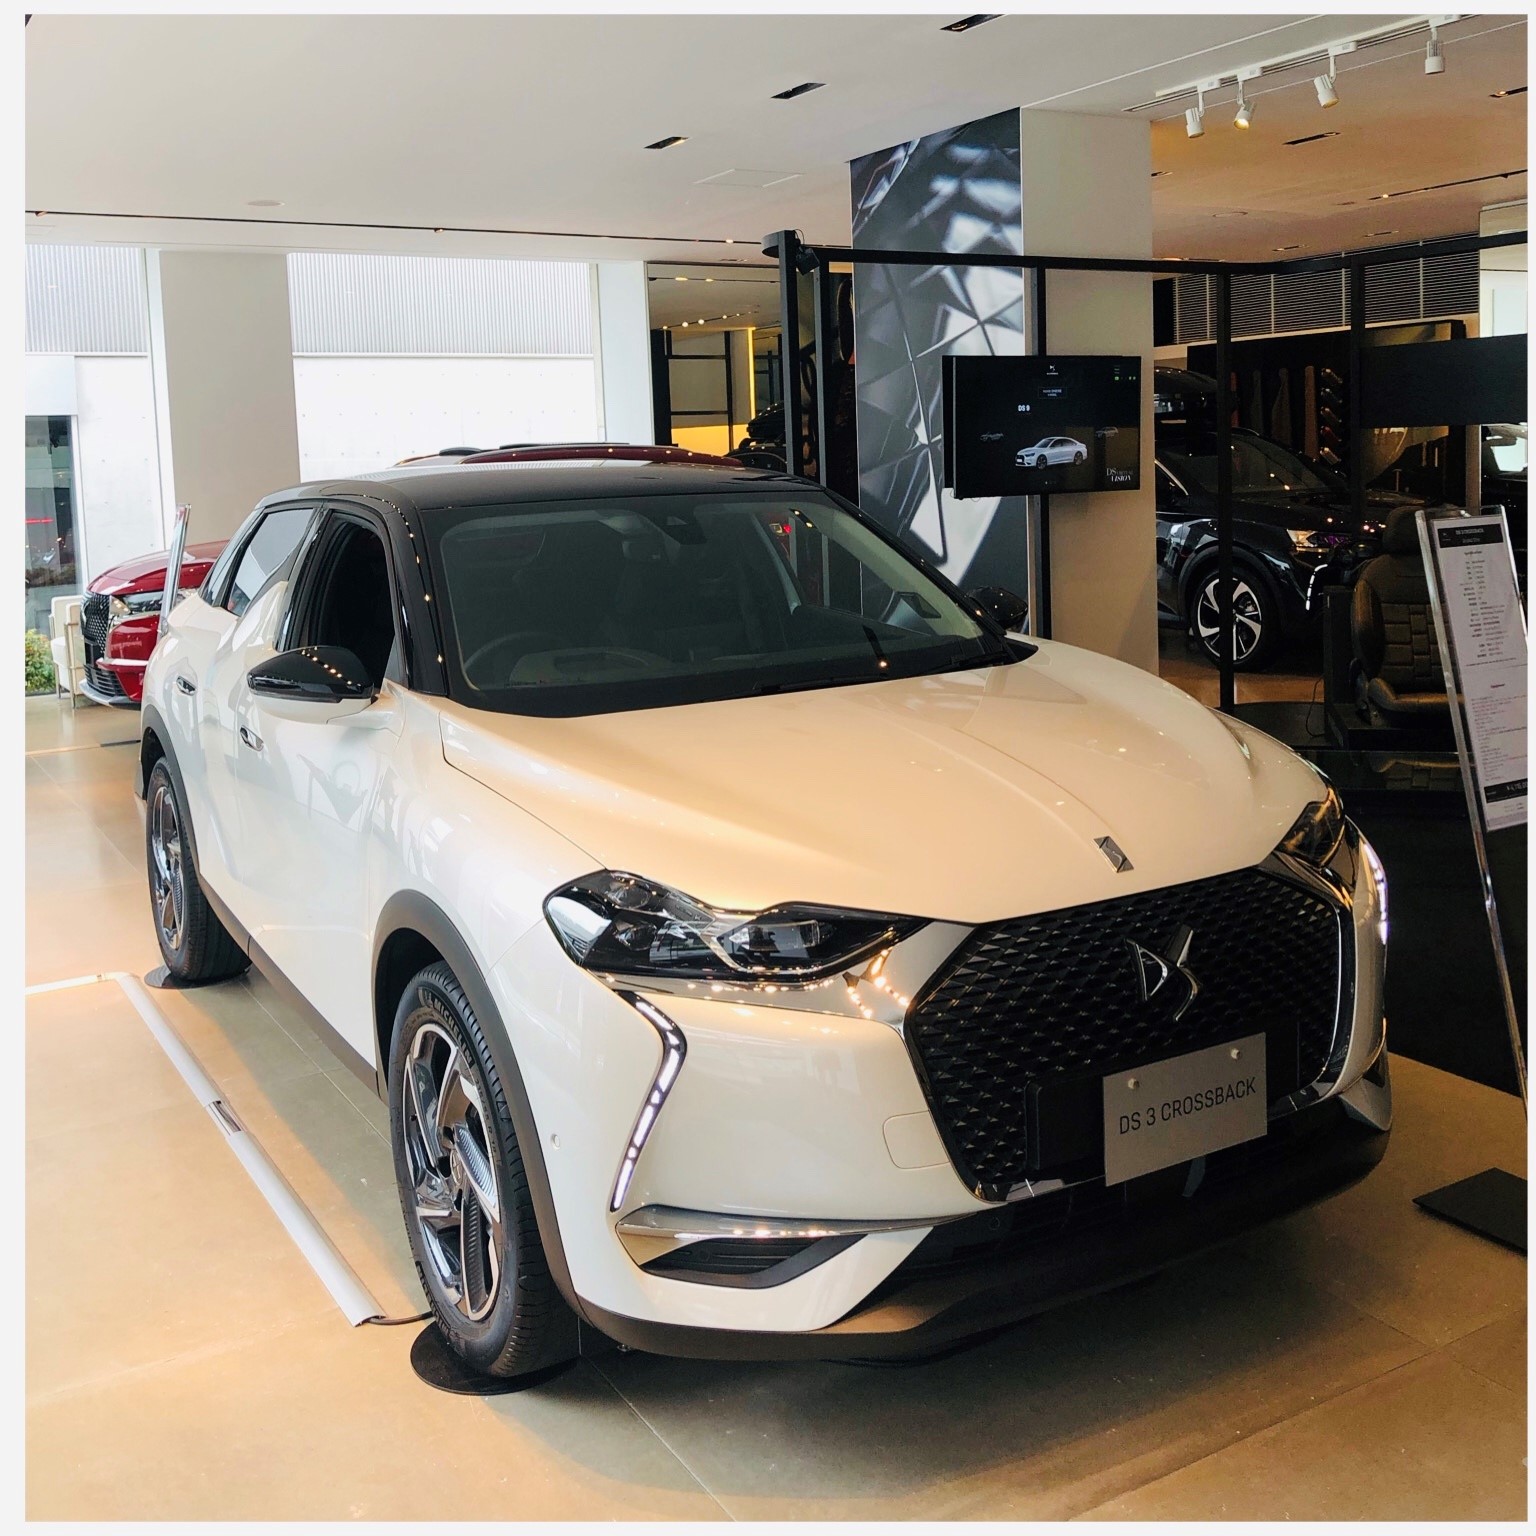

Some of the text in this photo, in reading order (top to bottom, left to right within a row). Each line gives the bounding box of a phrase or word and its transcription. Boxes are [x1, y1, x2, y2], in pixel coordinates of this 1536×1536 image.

[433, 1001, 474, 1065] MICHELIN
[1120, 1077, 1256, 1134] DS 3 CROSSBACK
